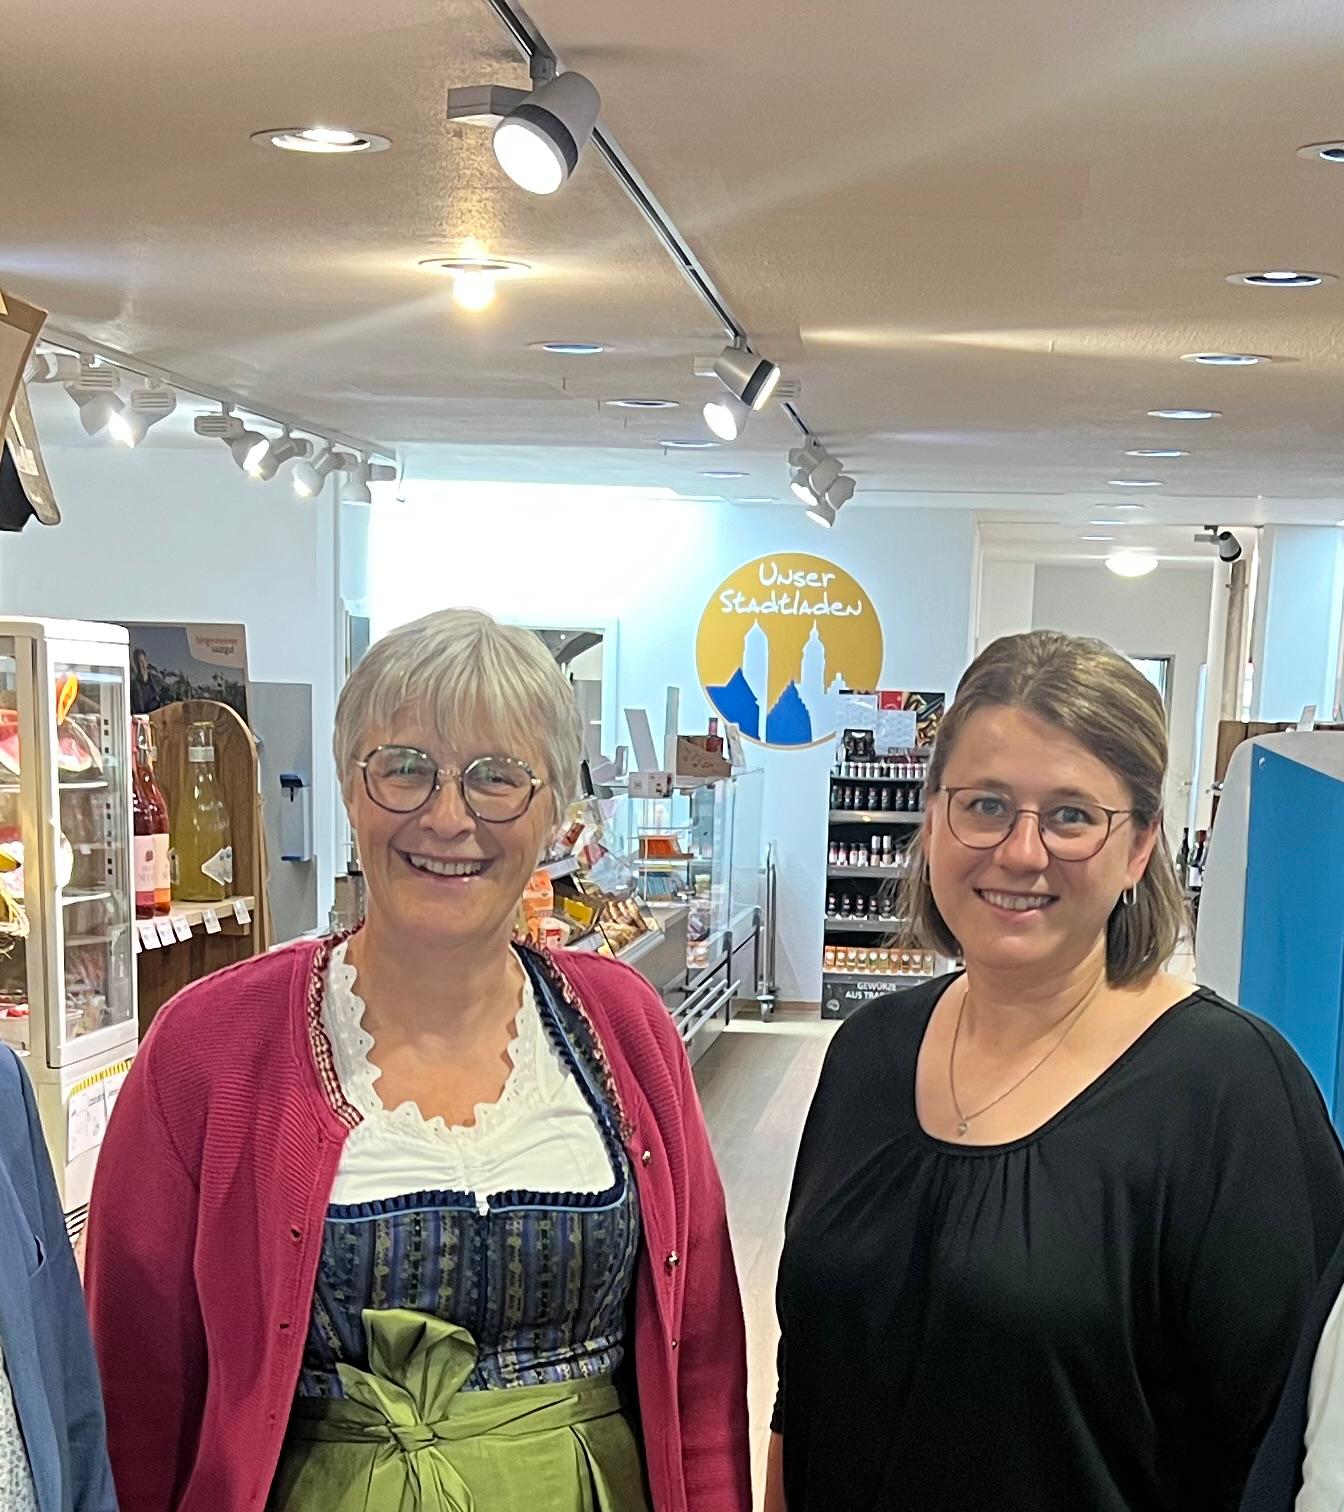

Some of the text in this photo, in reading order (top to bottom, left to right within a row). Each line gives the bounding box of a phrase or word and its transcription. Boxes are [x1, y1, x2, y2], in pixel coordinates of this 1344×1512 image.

[758, 562, 836, 588] Unser
[719, 589, 863, 617] Stadtladen
[845, 991, 863, 999] AUS
[857, 981, 897, 992] GEWÜRZE
